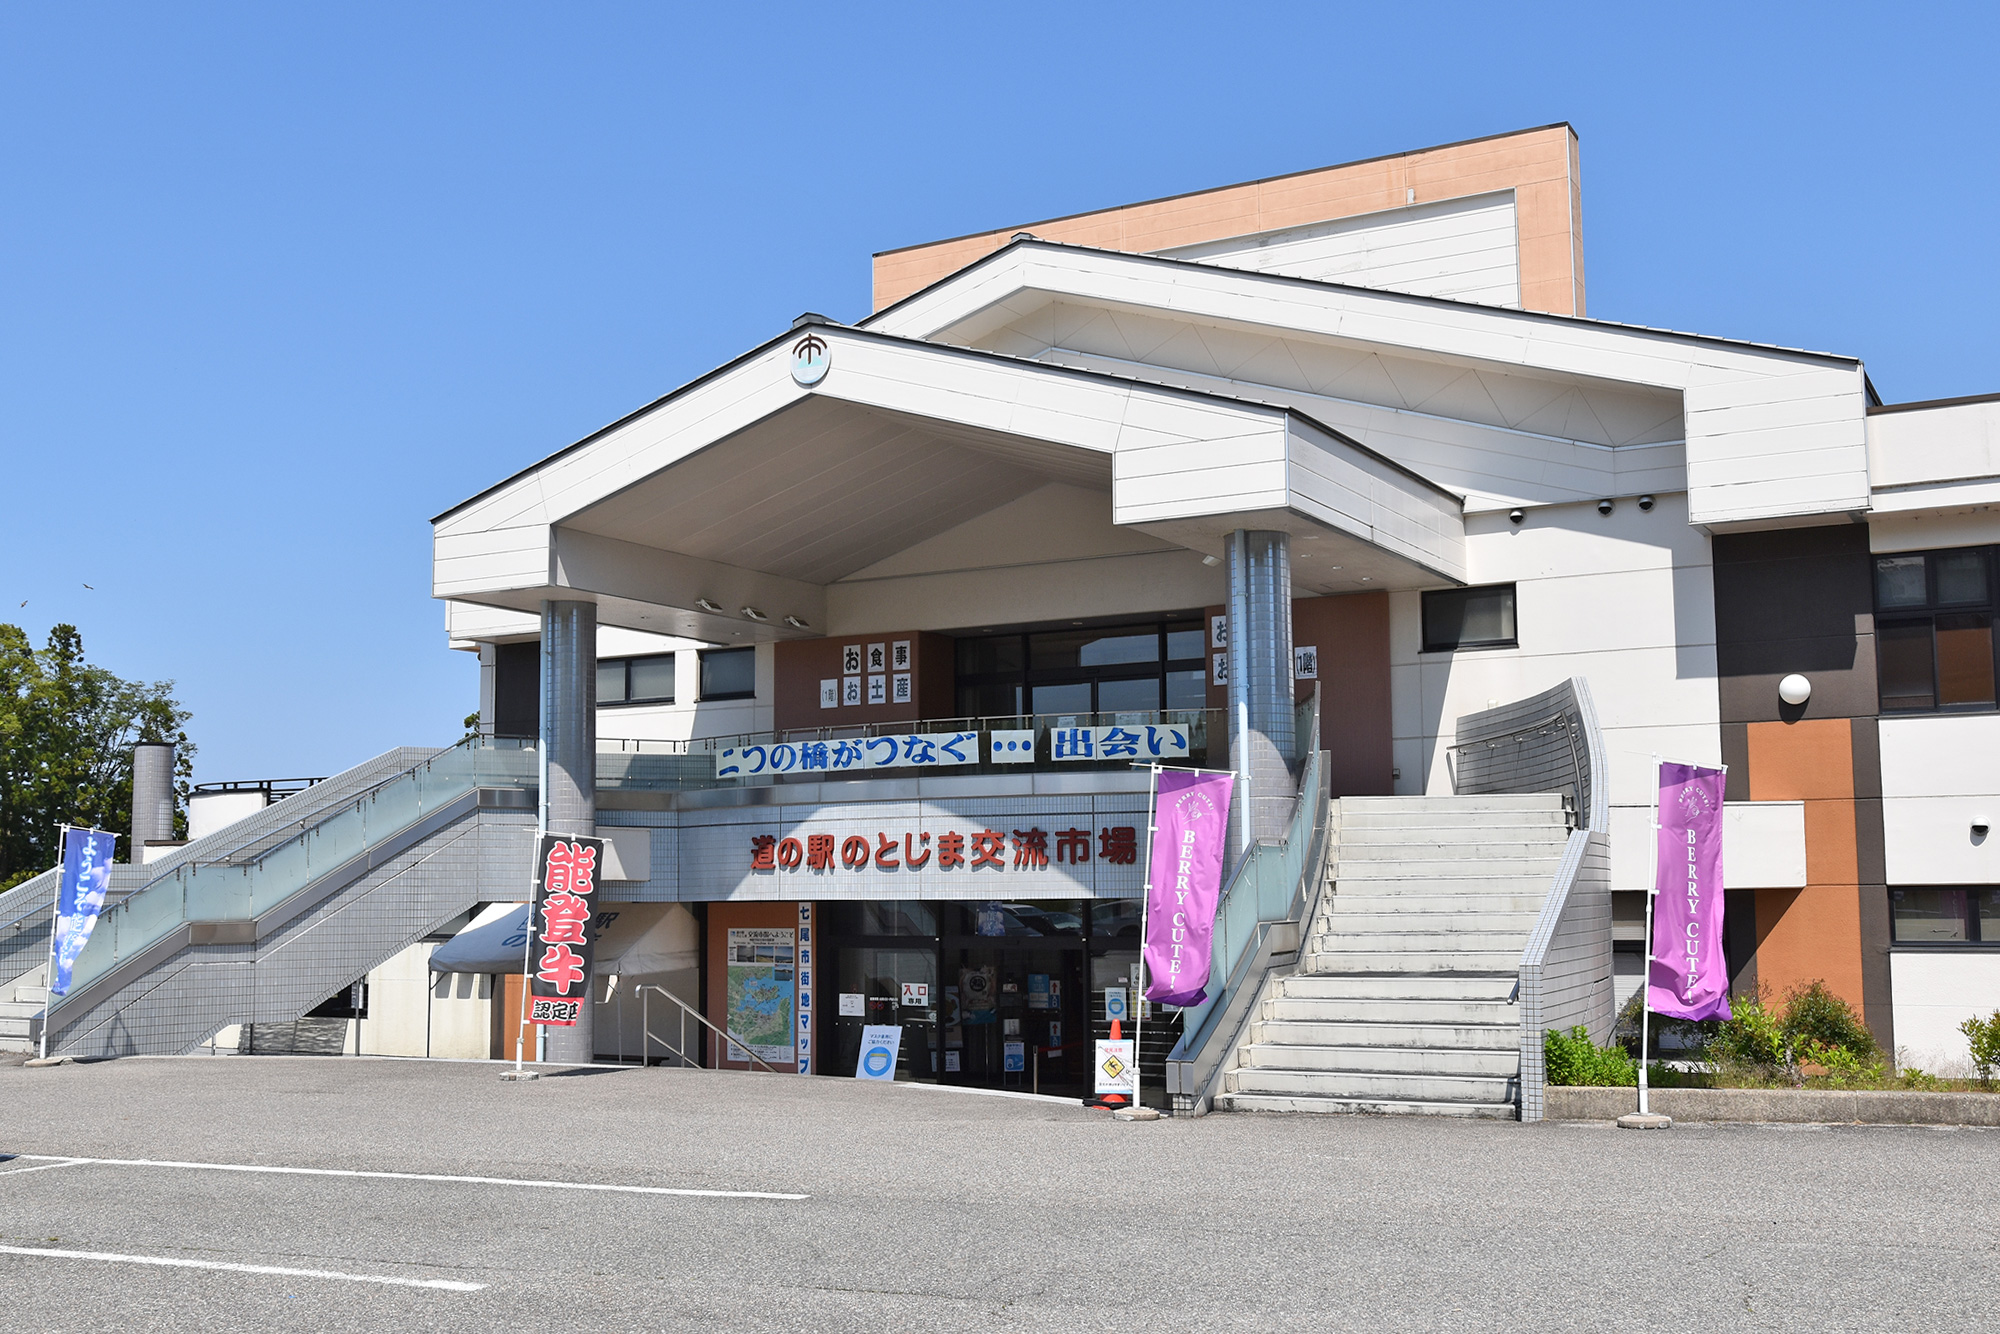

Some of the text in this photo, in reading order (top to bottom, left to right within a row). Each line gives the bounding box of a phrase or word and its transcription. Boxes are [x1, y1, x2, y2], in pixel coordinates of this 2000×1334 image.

[845, 645, 907, 671] お食事
[847, 678, 908, 701] お土産
[1055, 726, 1187, 758] 出会い
[1175, 792, 1195, 808] BERRY
[750, 827, 1137, 870] 道の駅のとじま交流市場
[73, 836, 98, 911] ようこそ
[537, 841, 597, 995] 能登牛
[1169, 829, 1196, 989] BERRY CUTE!
[1686, 829, 1700, 1004] BERRY CUTE!
[799, 906, 809, 1074] 七尾市街地マップ
[903, 984, 927, 996] 入口
[532, 1000, 578, 1020] 認定店
